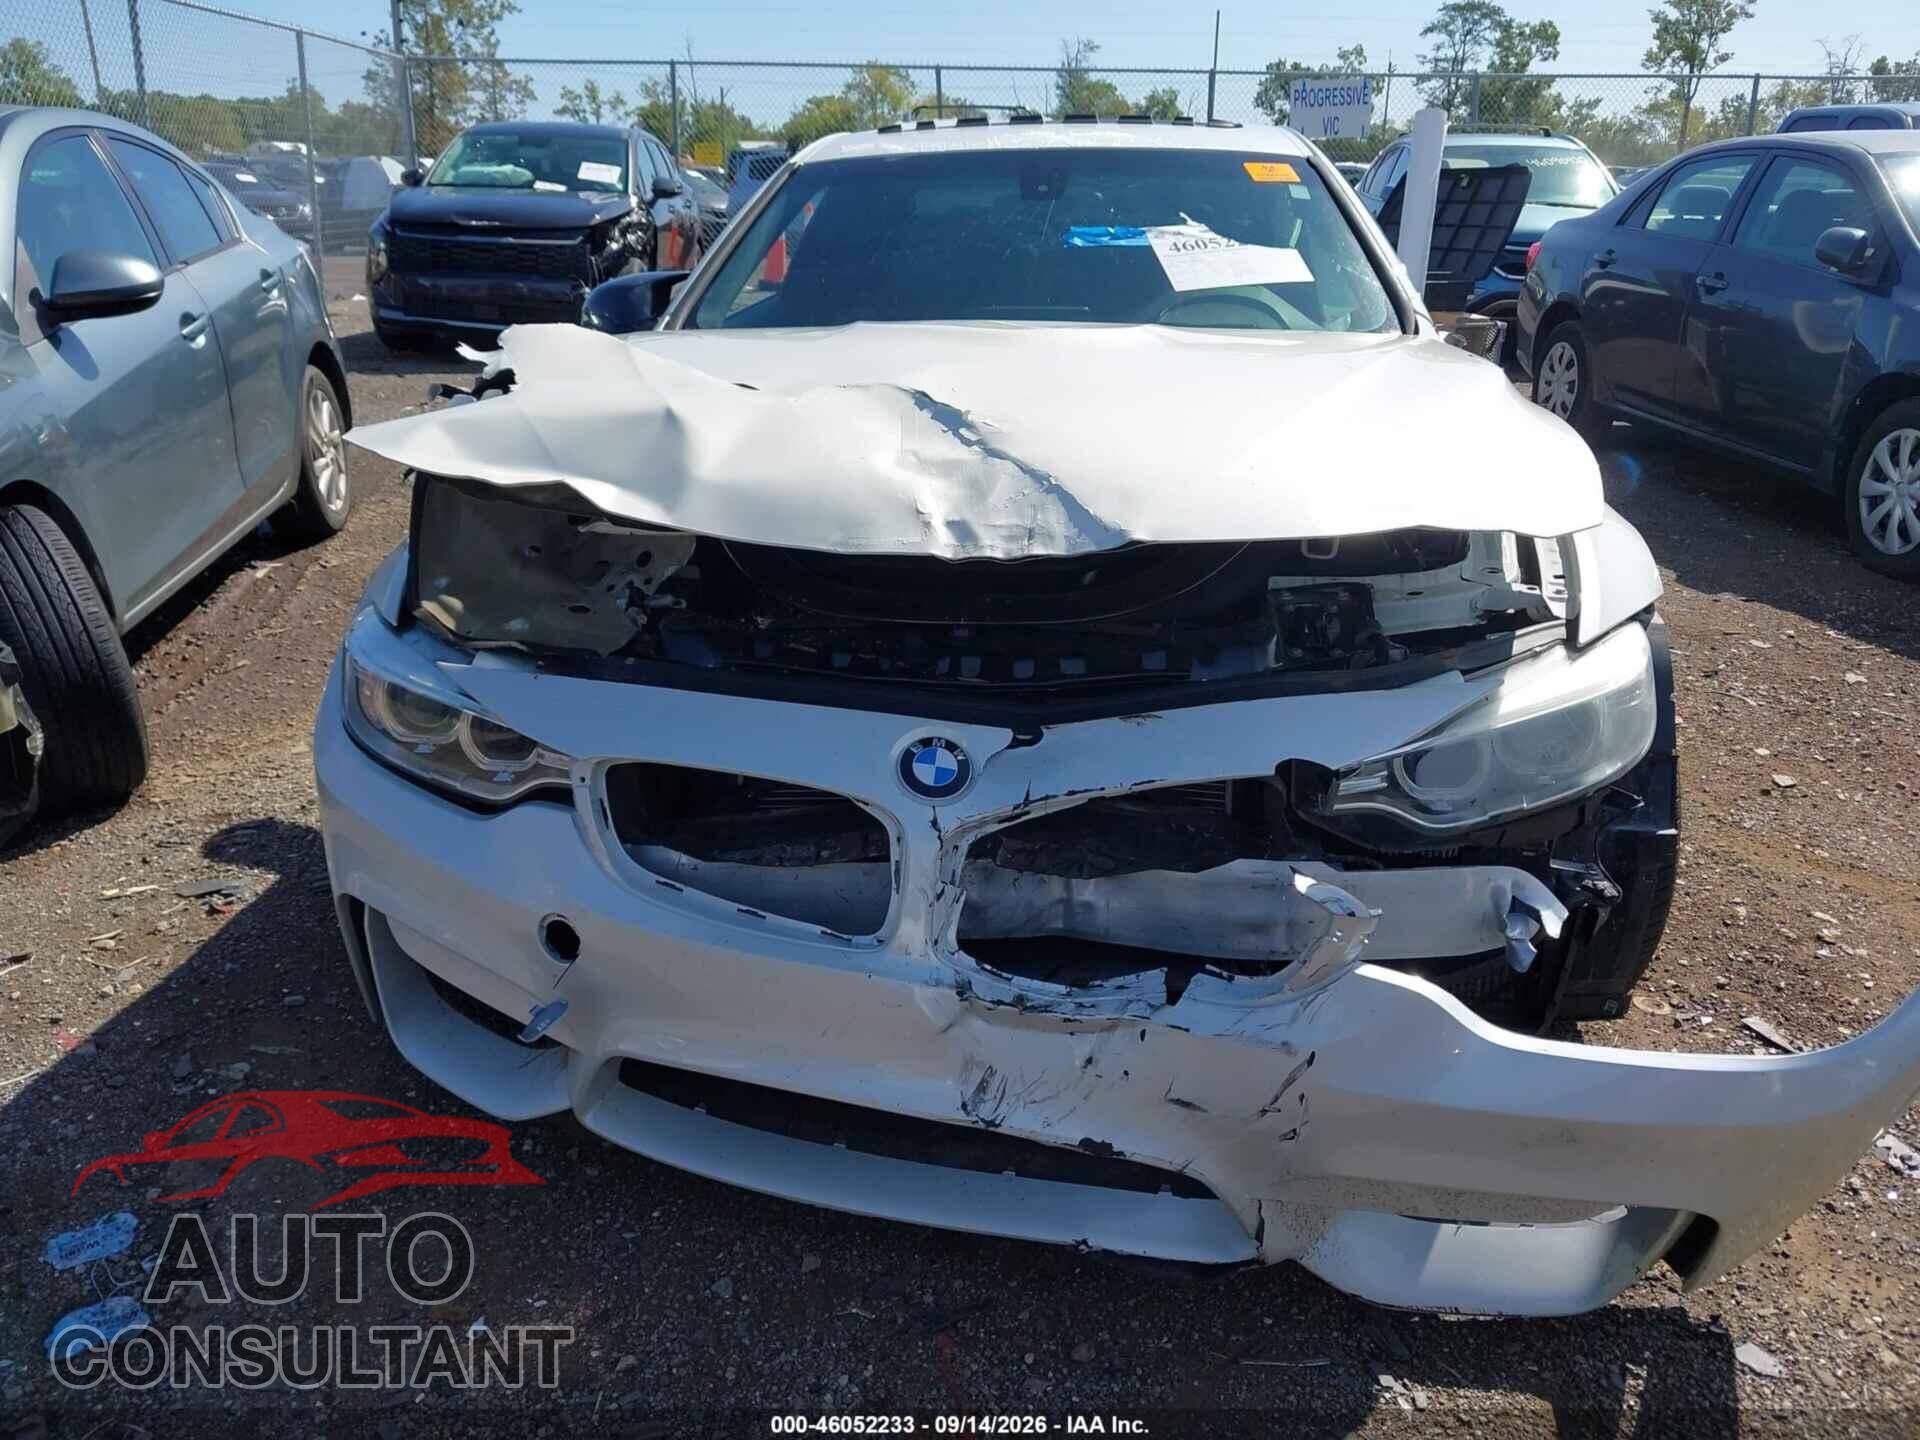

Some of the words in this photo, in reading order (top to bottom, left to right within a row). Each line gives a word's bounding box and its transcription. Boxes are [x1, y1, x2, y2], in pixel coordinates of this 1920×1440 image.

[1294, 86, 1369, 108] PROGRESSIVE
[1322, 115, 1340, 136] VIC
[910, 738, 967, 760] BMW
